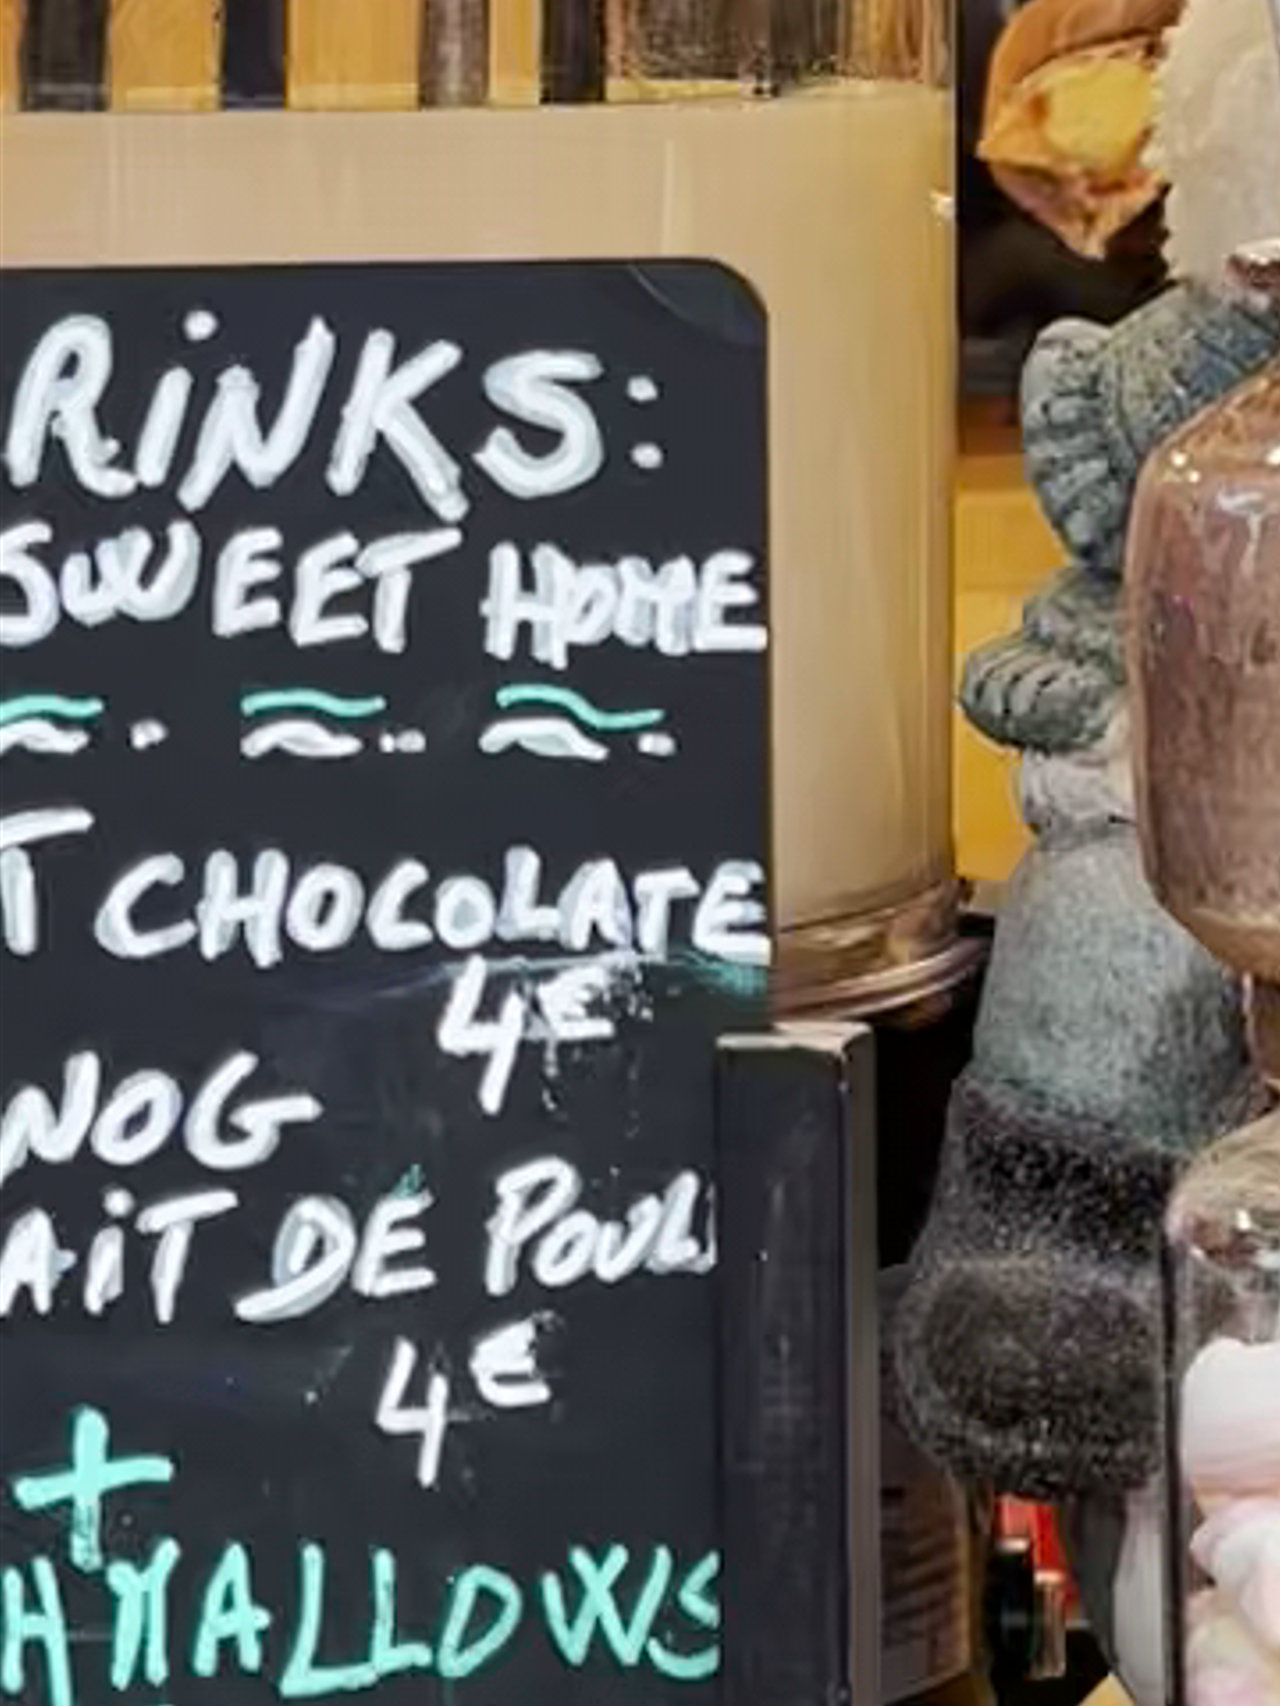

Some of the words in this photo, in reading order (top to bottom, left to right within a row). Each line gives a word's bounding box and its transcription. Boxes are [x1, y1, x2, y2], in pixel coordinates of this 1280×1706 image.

[0, 521, 462, 653] SWEET
[480, 542, 768, 669] HOME
[95, 846, 772, 968] CHOCOLATE
[234, 1192, 436, 1323] DE
